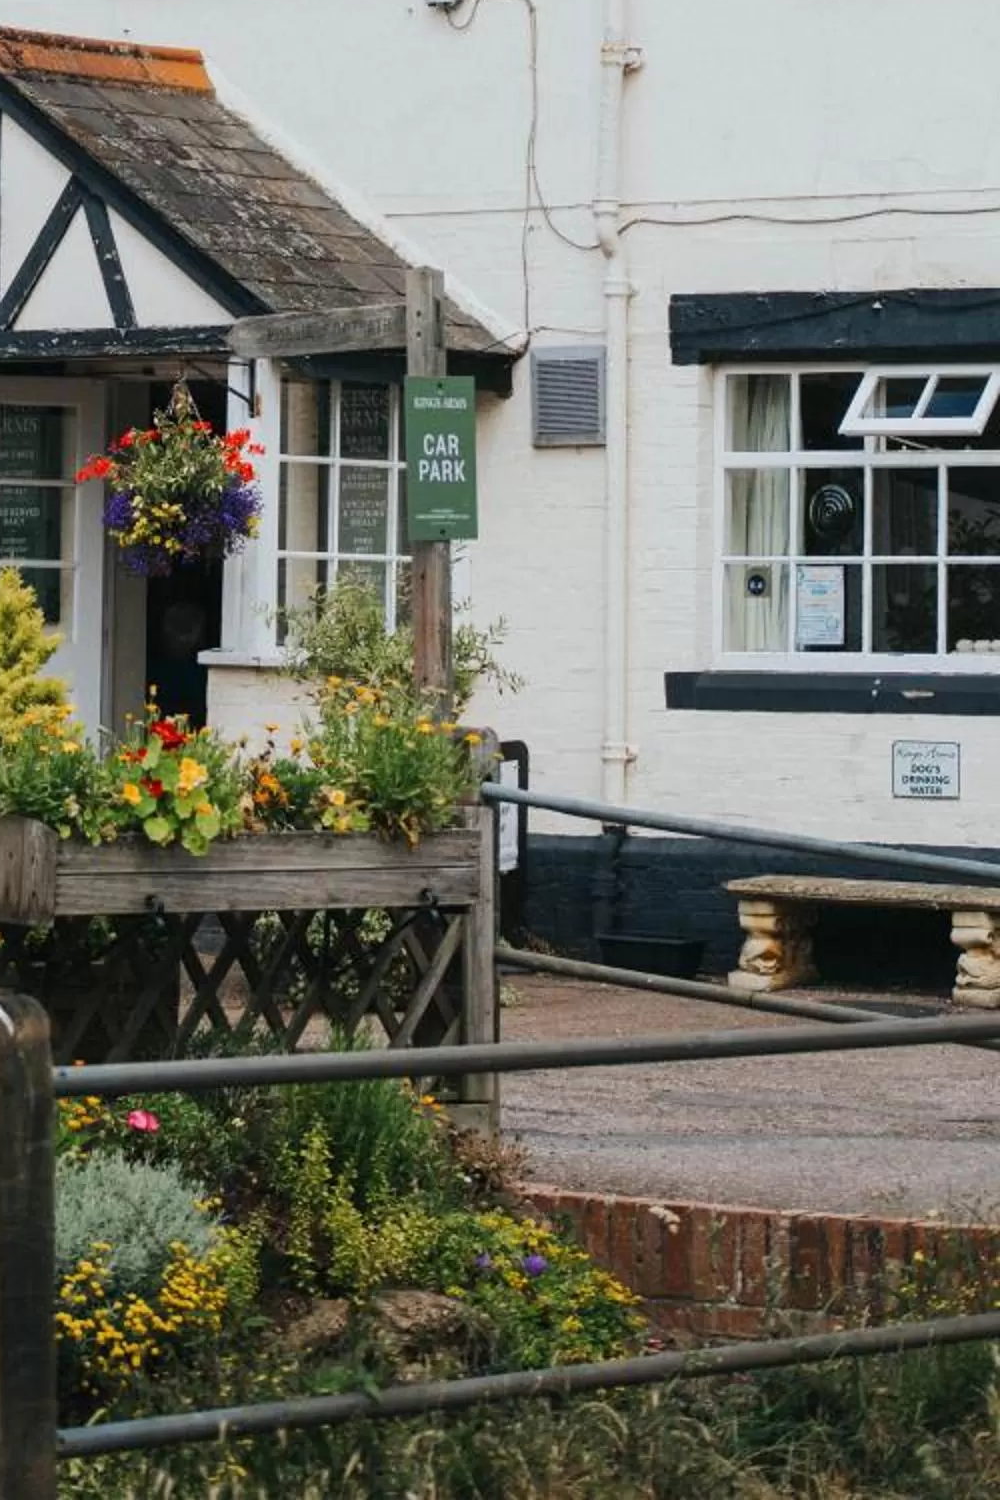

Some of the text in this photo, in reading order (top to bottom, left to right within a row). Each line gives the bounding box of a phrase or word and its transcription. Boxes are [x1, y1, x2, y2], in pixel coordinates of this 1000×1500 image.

[423, 433, 460, 456] CAR
[418, 459, 466, 483] PARK
[911, 764, 941, 774] DOG'S
[901, 775, 951, 785] DRINKING
[909, 785, 943, 795] WATER
